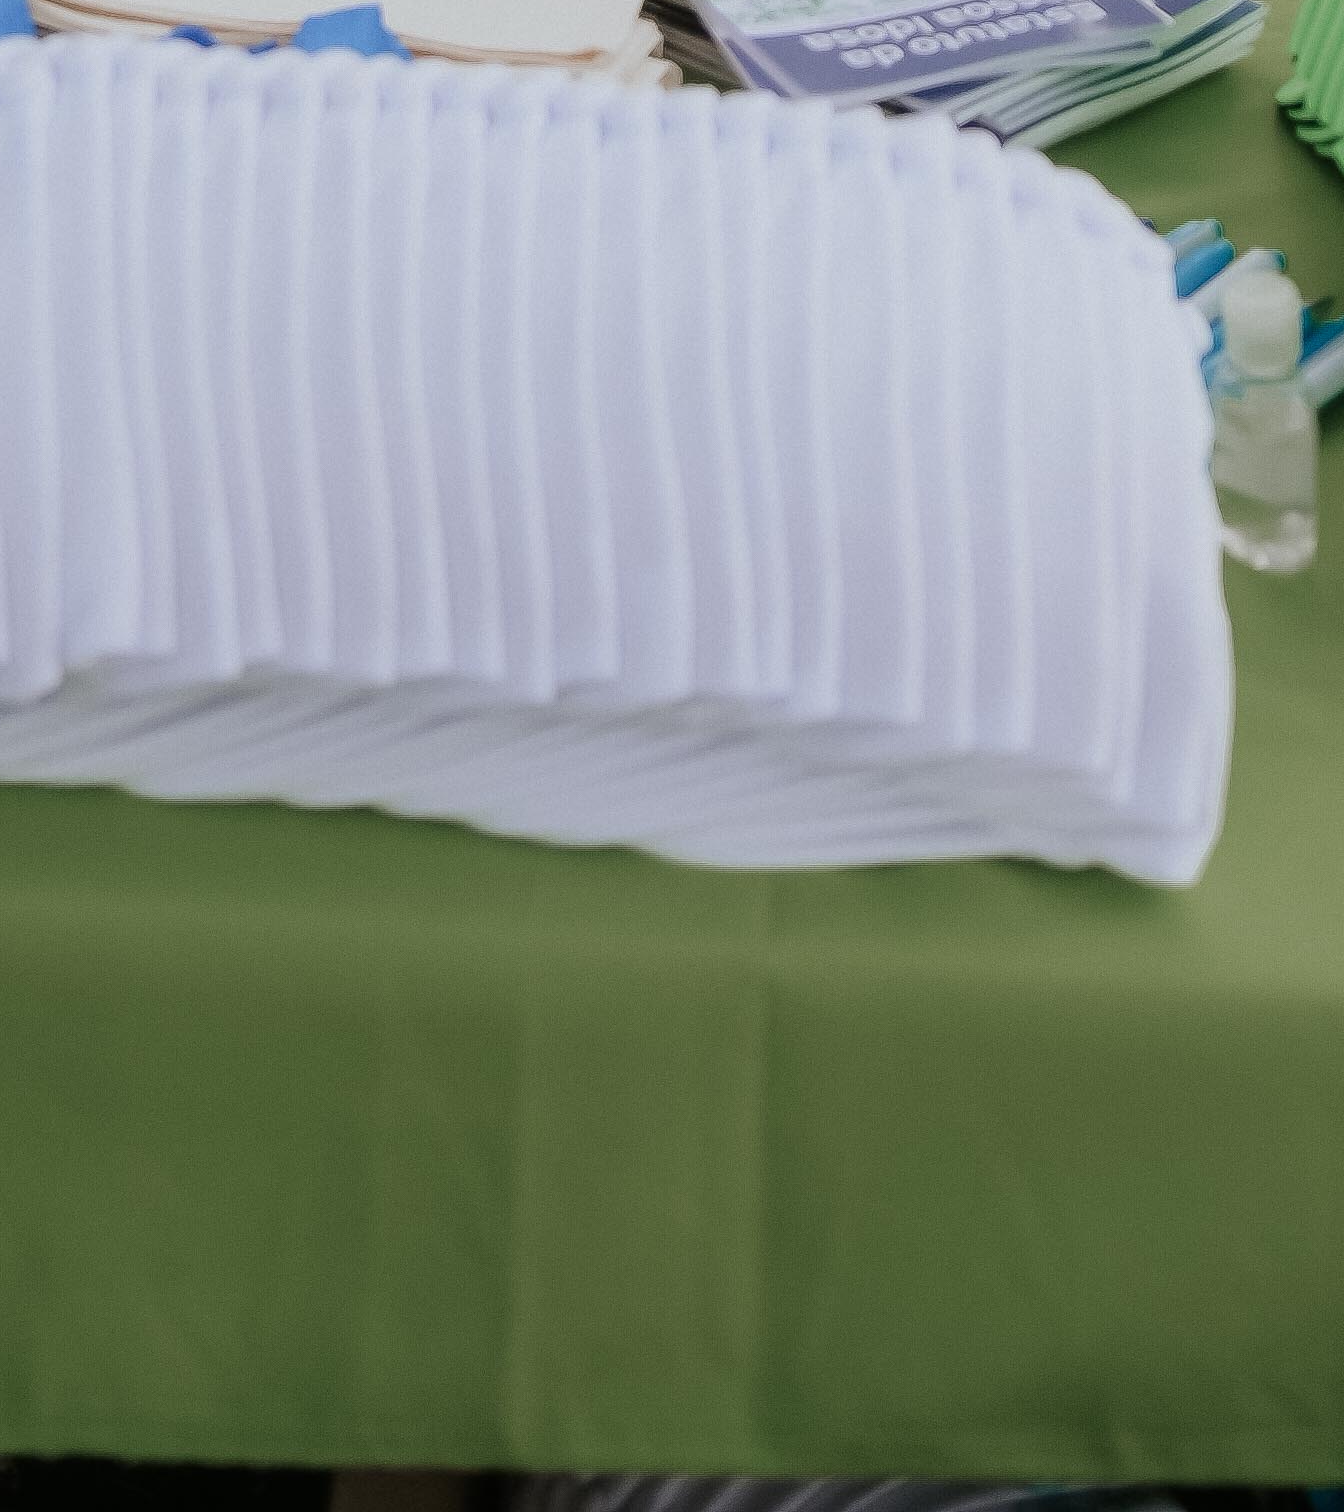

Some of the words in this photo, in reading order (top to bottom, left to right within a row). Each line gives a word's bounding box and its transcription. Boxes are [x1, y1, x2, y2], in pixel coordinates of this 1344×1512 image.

[800, 15, 936, 52] Idosa
[906, 0, 1108, 58] Estatuto
[840, 42, 906, 70] da
